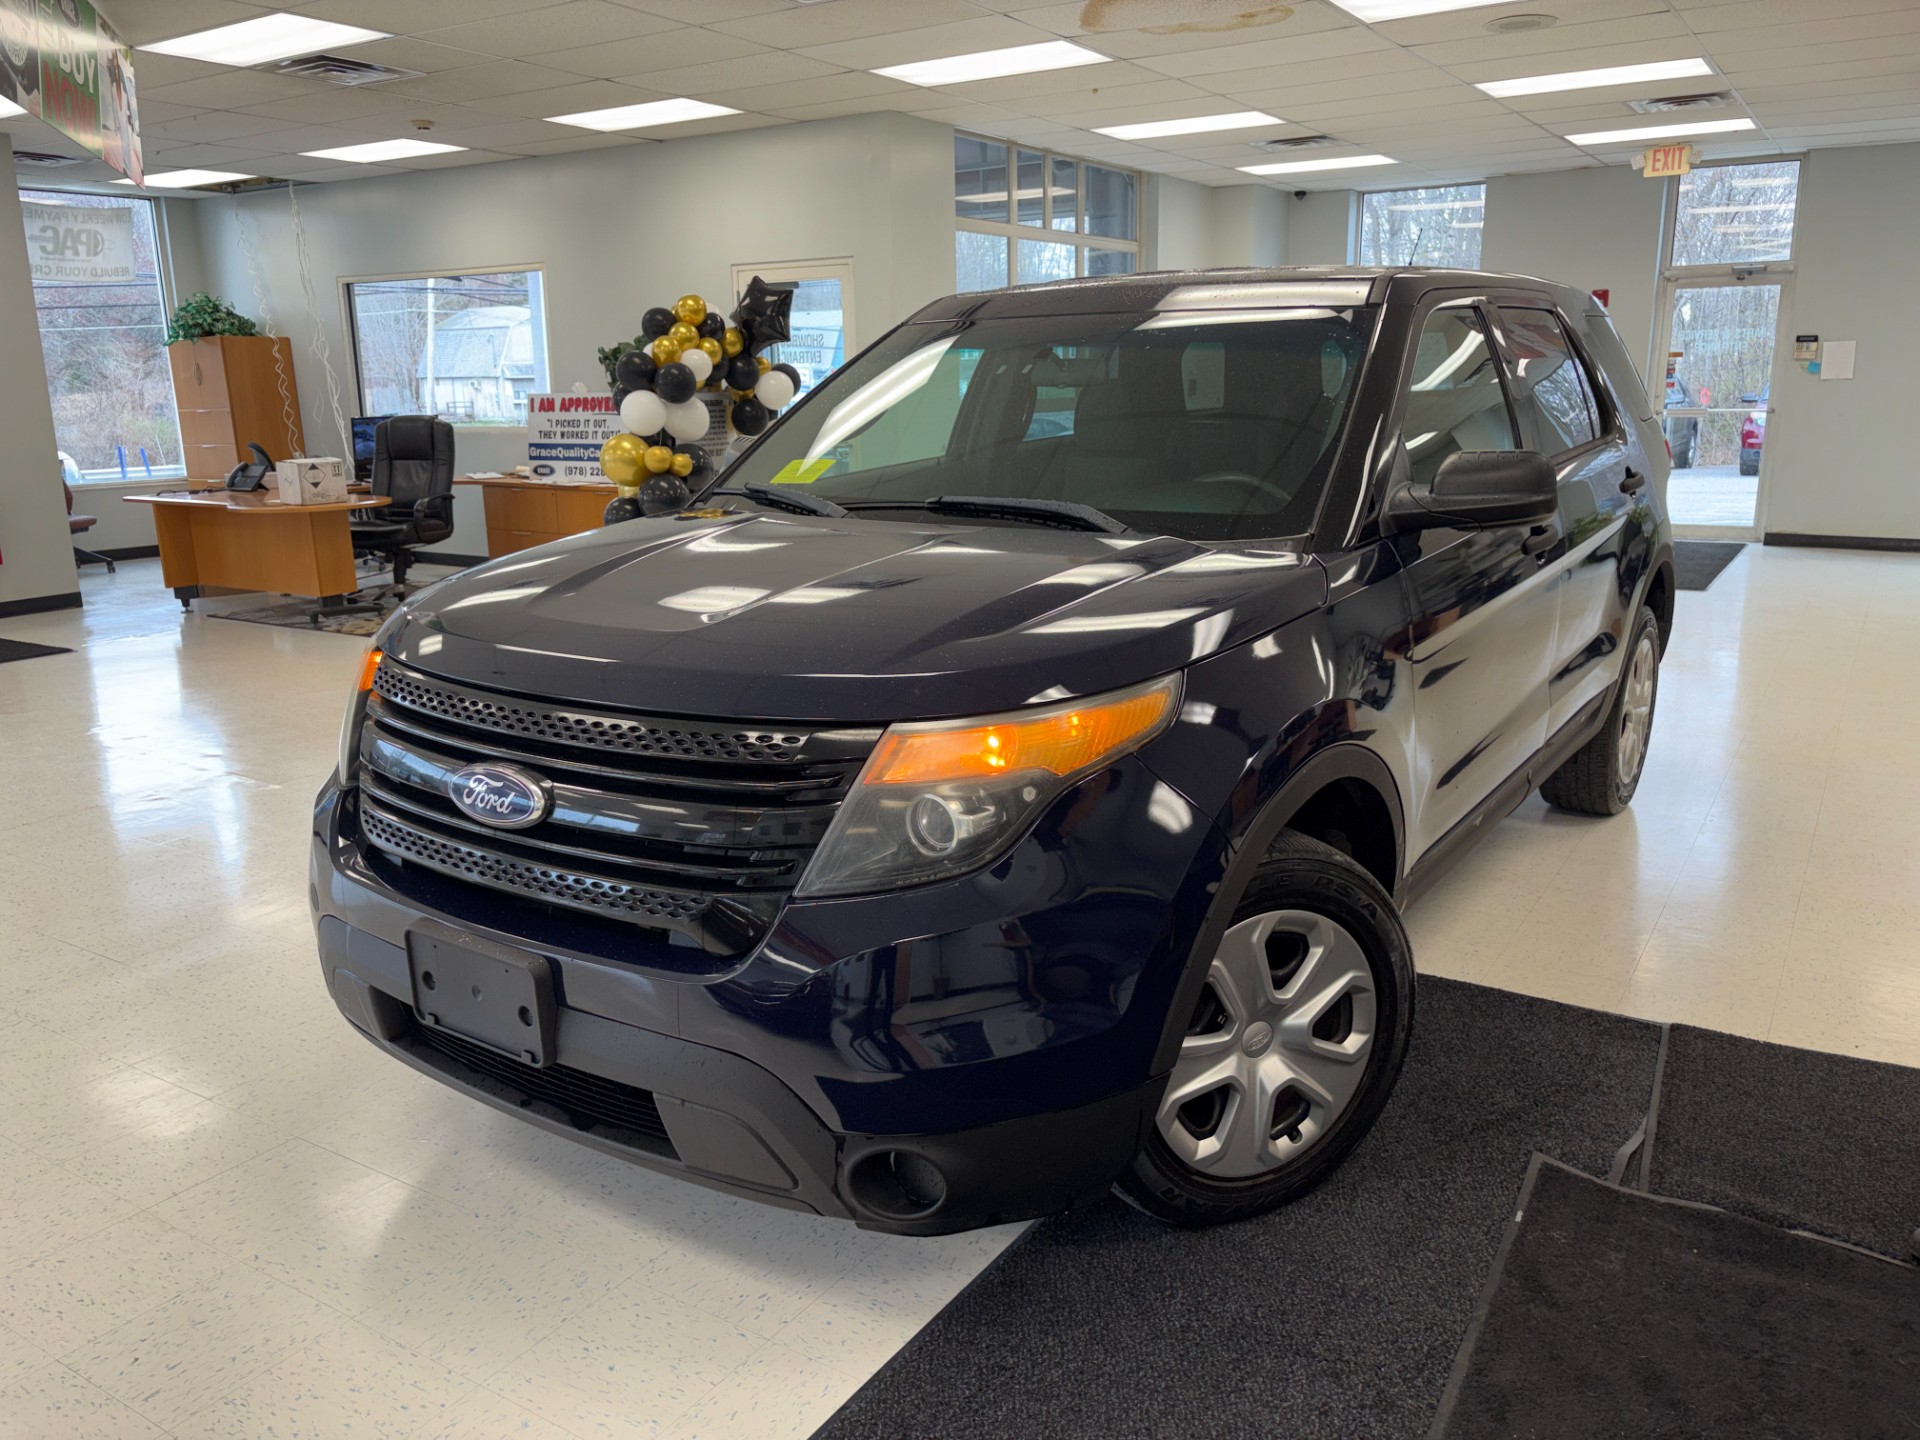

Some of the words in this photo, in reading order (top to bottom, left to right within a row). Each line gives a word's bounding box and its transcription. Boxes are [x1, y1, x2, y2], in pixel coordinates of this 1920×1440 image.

[59, 30, 95, 94] BUY
[1651, 146, 1685, 172] EXIT
[530, 397, 535, 413] I
[538, 397, 555, 413] AM
[555, 419, 581, 428] PICKED
[584, 419, 591, 428] IT
[538, 430, 557, 440] THEY
[560, 430, 590, 440] WORKED
[592, 430, 599, 440] IT
[564, 466, 587, 478] (978)
[463, 774, 516, 814] Ford
